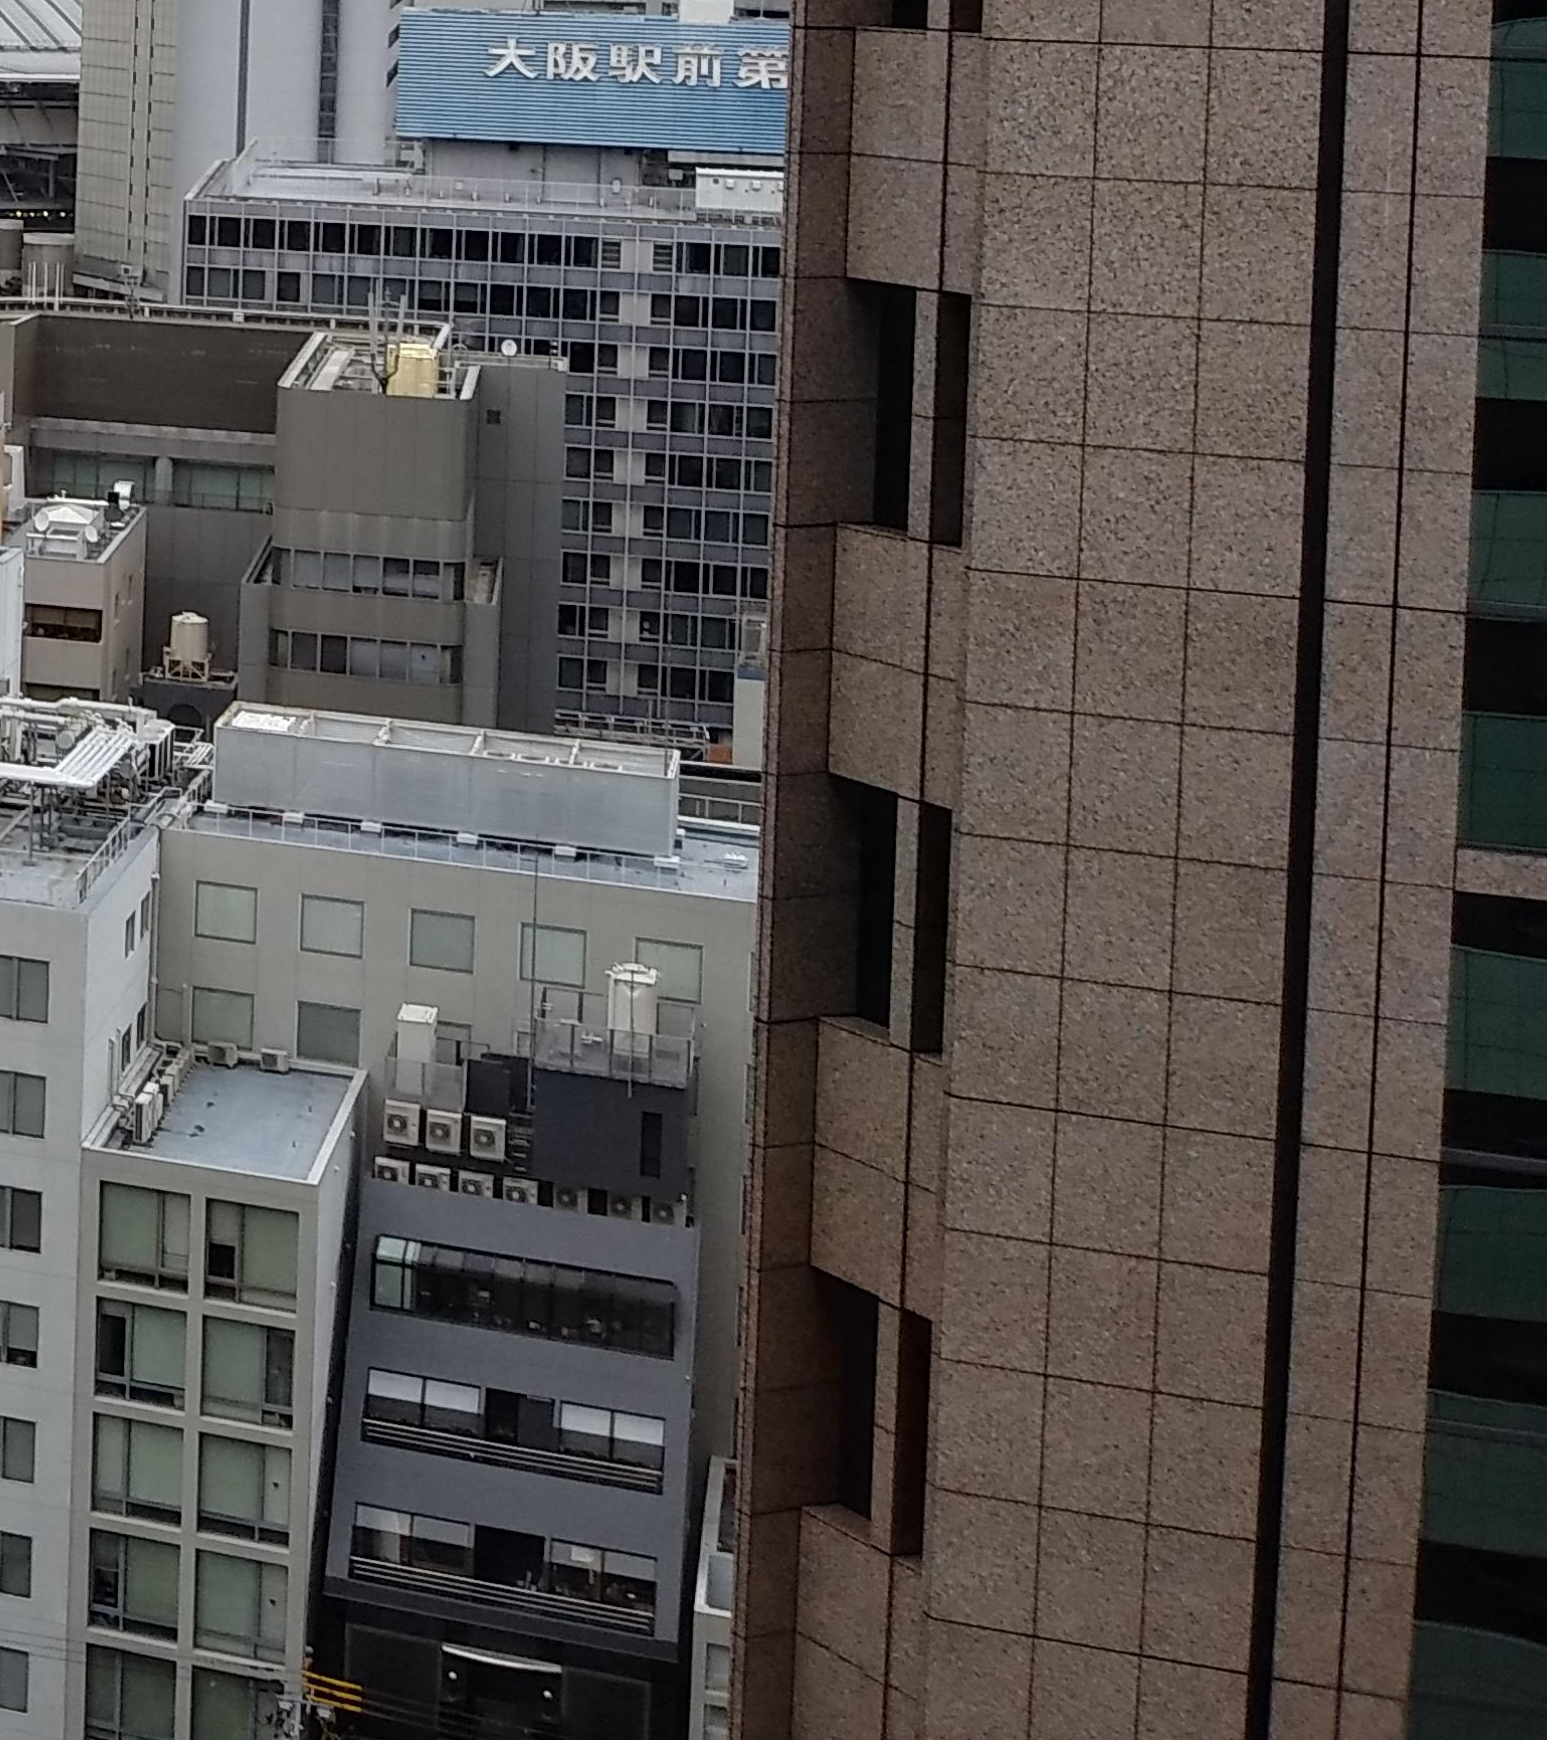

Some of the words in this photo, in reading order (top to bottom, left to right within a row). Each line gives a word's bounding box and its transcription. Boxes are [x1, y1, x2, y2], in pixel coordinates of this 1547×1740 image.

[484, 37, 788, 90] 大阪駅前第
